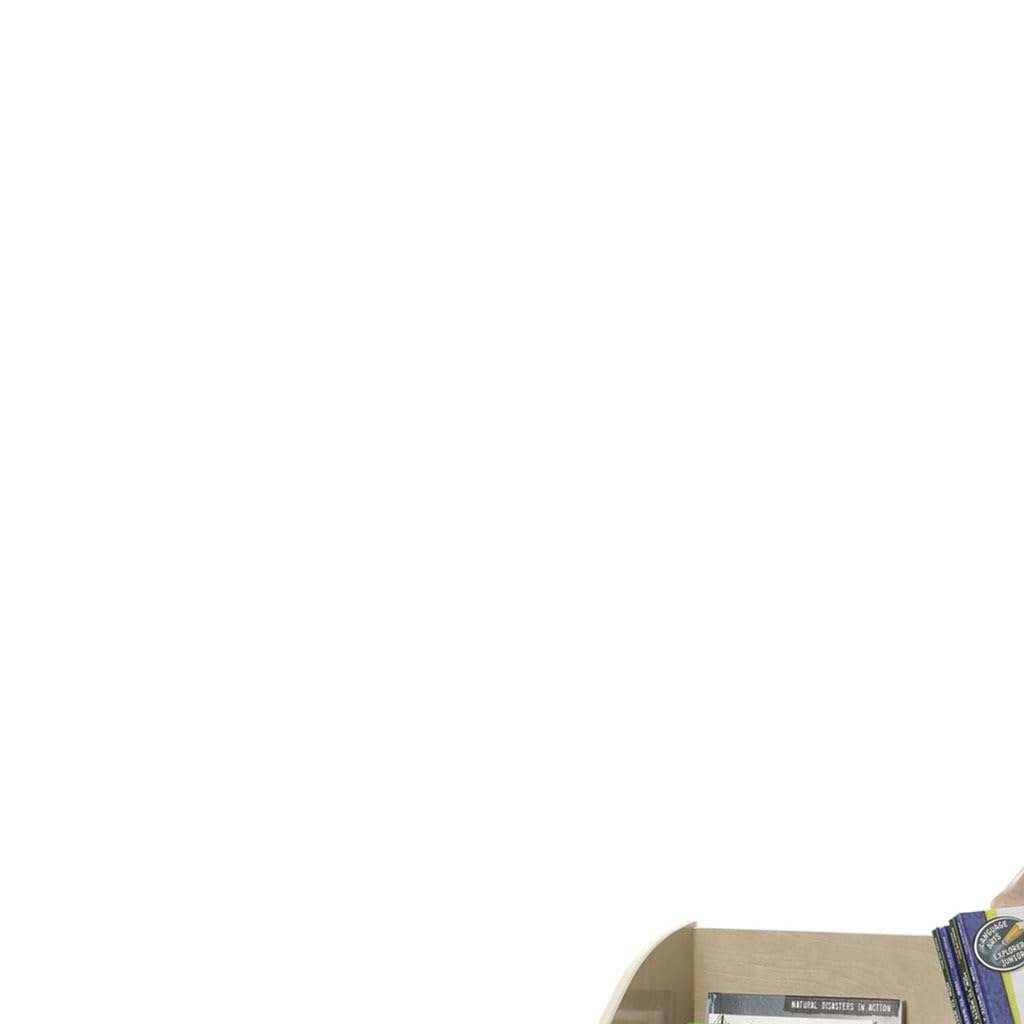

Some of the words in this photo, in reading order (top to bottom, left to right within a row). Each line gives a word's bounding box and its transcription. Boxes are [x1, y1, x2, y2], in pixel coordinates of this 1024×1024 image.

[978, 920, 1008, 948] LANGUAGE
[986, 933, 1002, 950] ARTS
[790, 1000, 818, 1010] NATURAL
[822, 1001, 854, 1010] DISASTERS
[858, 1003, 865, 1011] IN
[868, 1003, 891, 1012] ACTION
